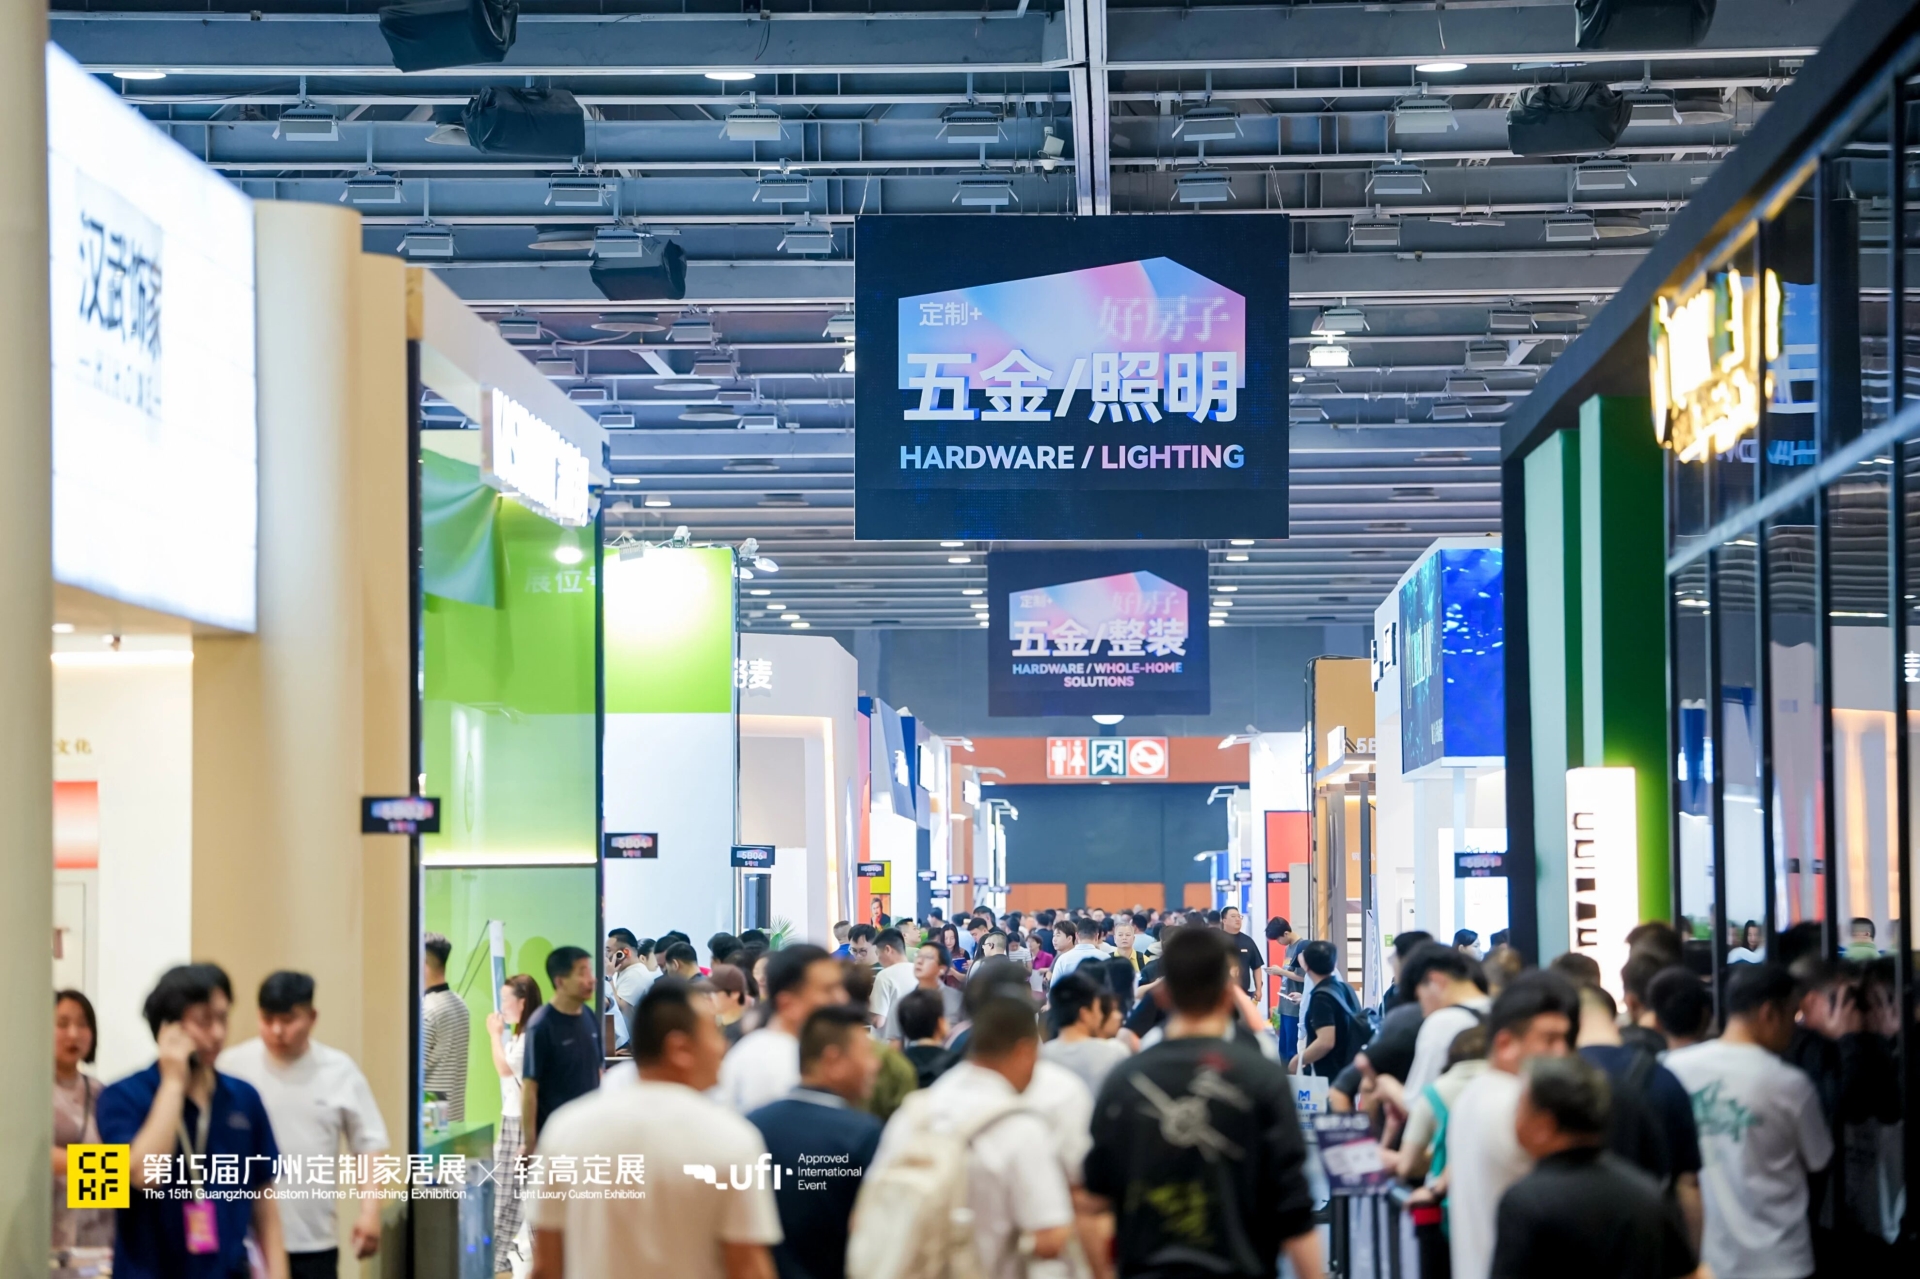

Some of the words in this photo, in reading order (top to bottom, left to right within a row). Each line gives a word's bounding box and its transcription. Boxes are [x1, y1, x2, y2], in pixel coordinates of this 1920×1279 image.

[919, 301, 983, 327] 定制+
[1098, 294, 1231, 344] 好房子
[903, 349, 1239, 424] 五金/照明
[900, 445, 1074, 470] HARDWARE
[1101, 444, 1245, 470] LIGHTING
[1012, 618, 1187, 657] 五金/整装
[1012, 663, 1085, 675] HARDWARE
[1093, 662, 1183, 674] WHOLE-HOME
[1063, 675, 1135, 688] SOLUTIONS
